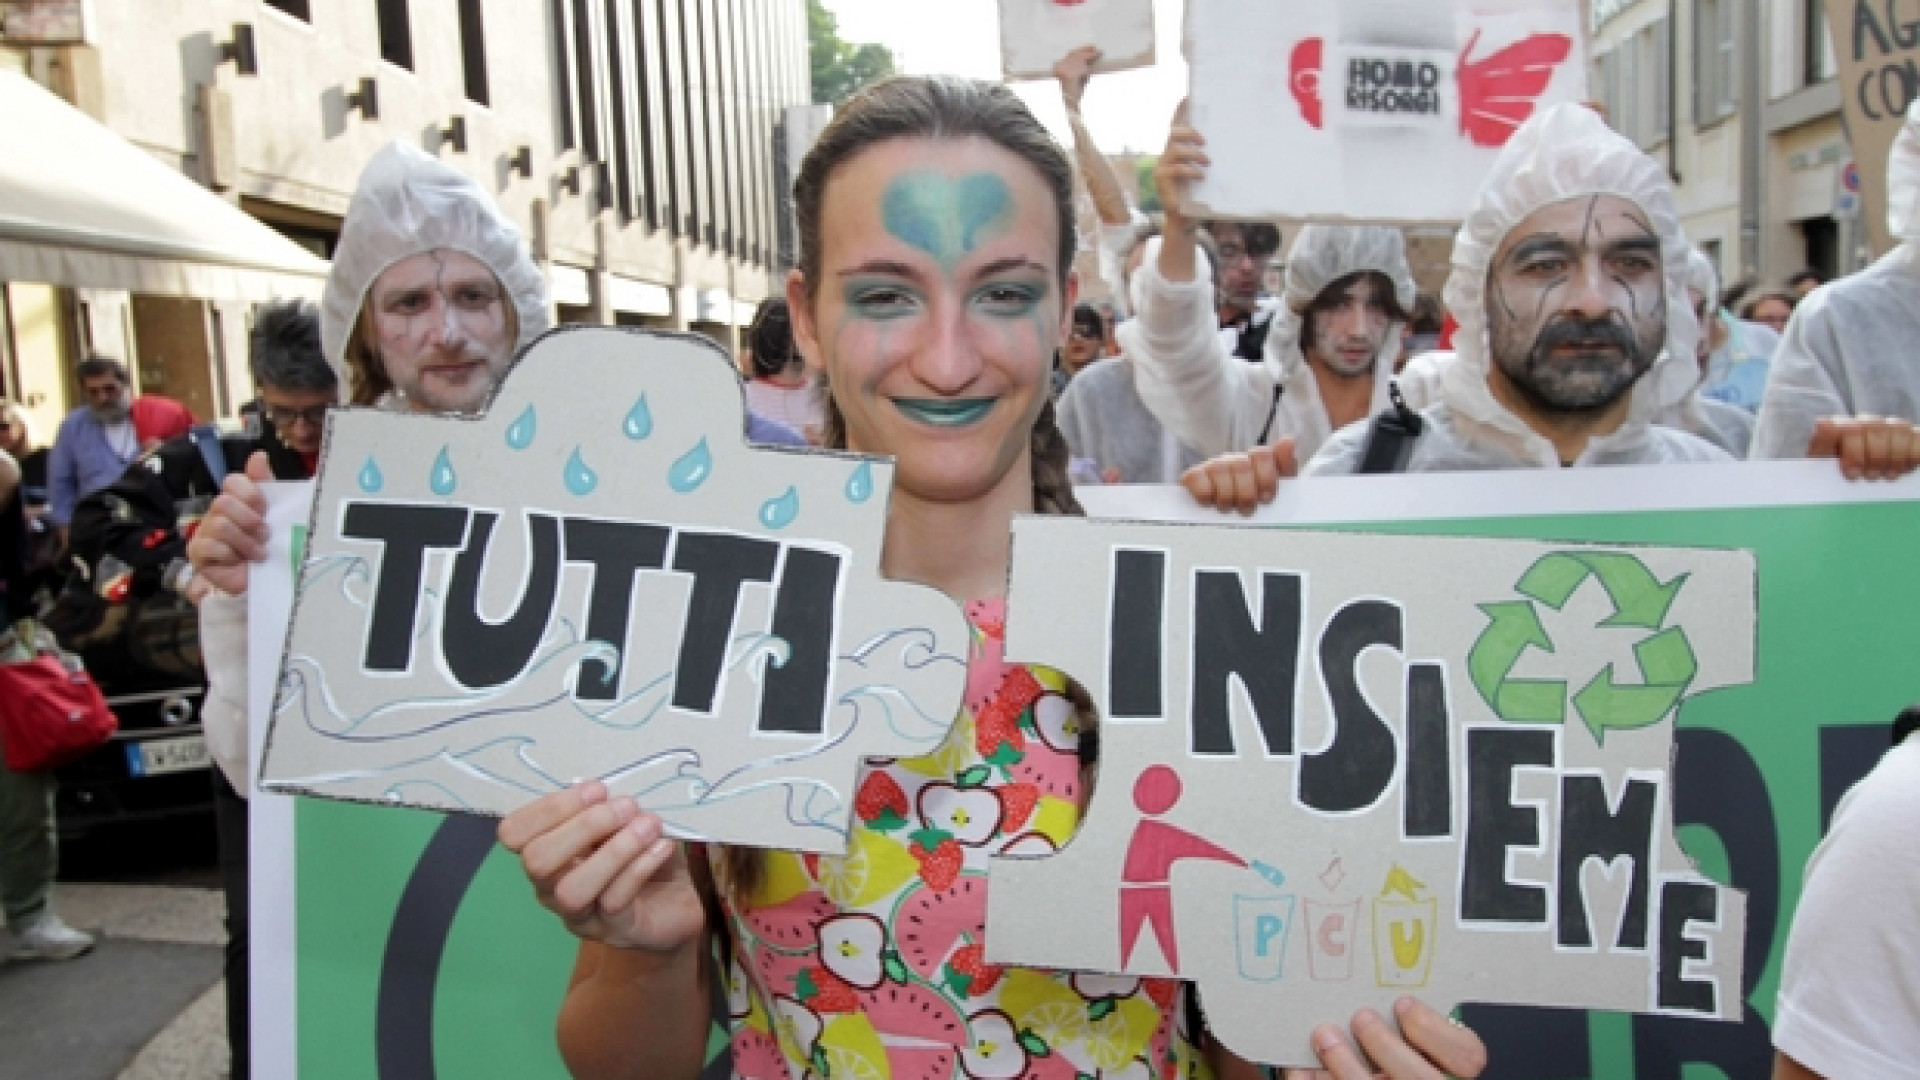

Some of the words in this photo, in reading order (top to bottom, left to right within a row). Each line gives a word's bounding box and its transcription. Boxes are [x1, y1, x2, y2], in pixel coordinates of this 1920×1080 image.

[1345, 87, 1440, 115] RISORGI
[1347, 57, 1438, 88] HOMO
[341, 500, 845, 735] TUTTI
[1108, 549, 1720, 1014] INSIEME
[1256, 914, 1283, 957] P
[1318, 912, 1345, 957] C
[1390, 918, 1425, 970] U
